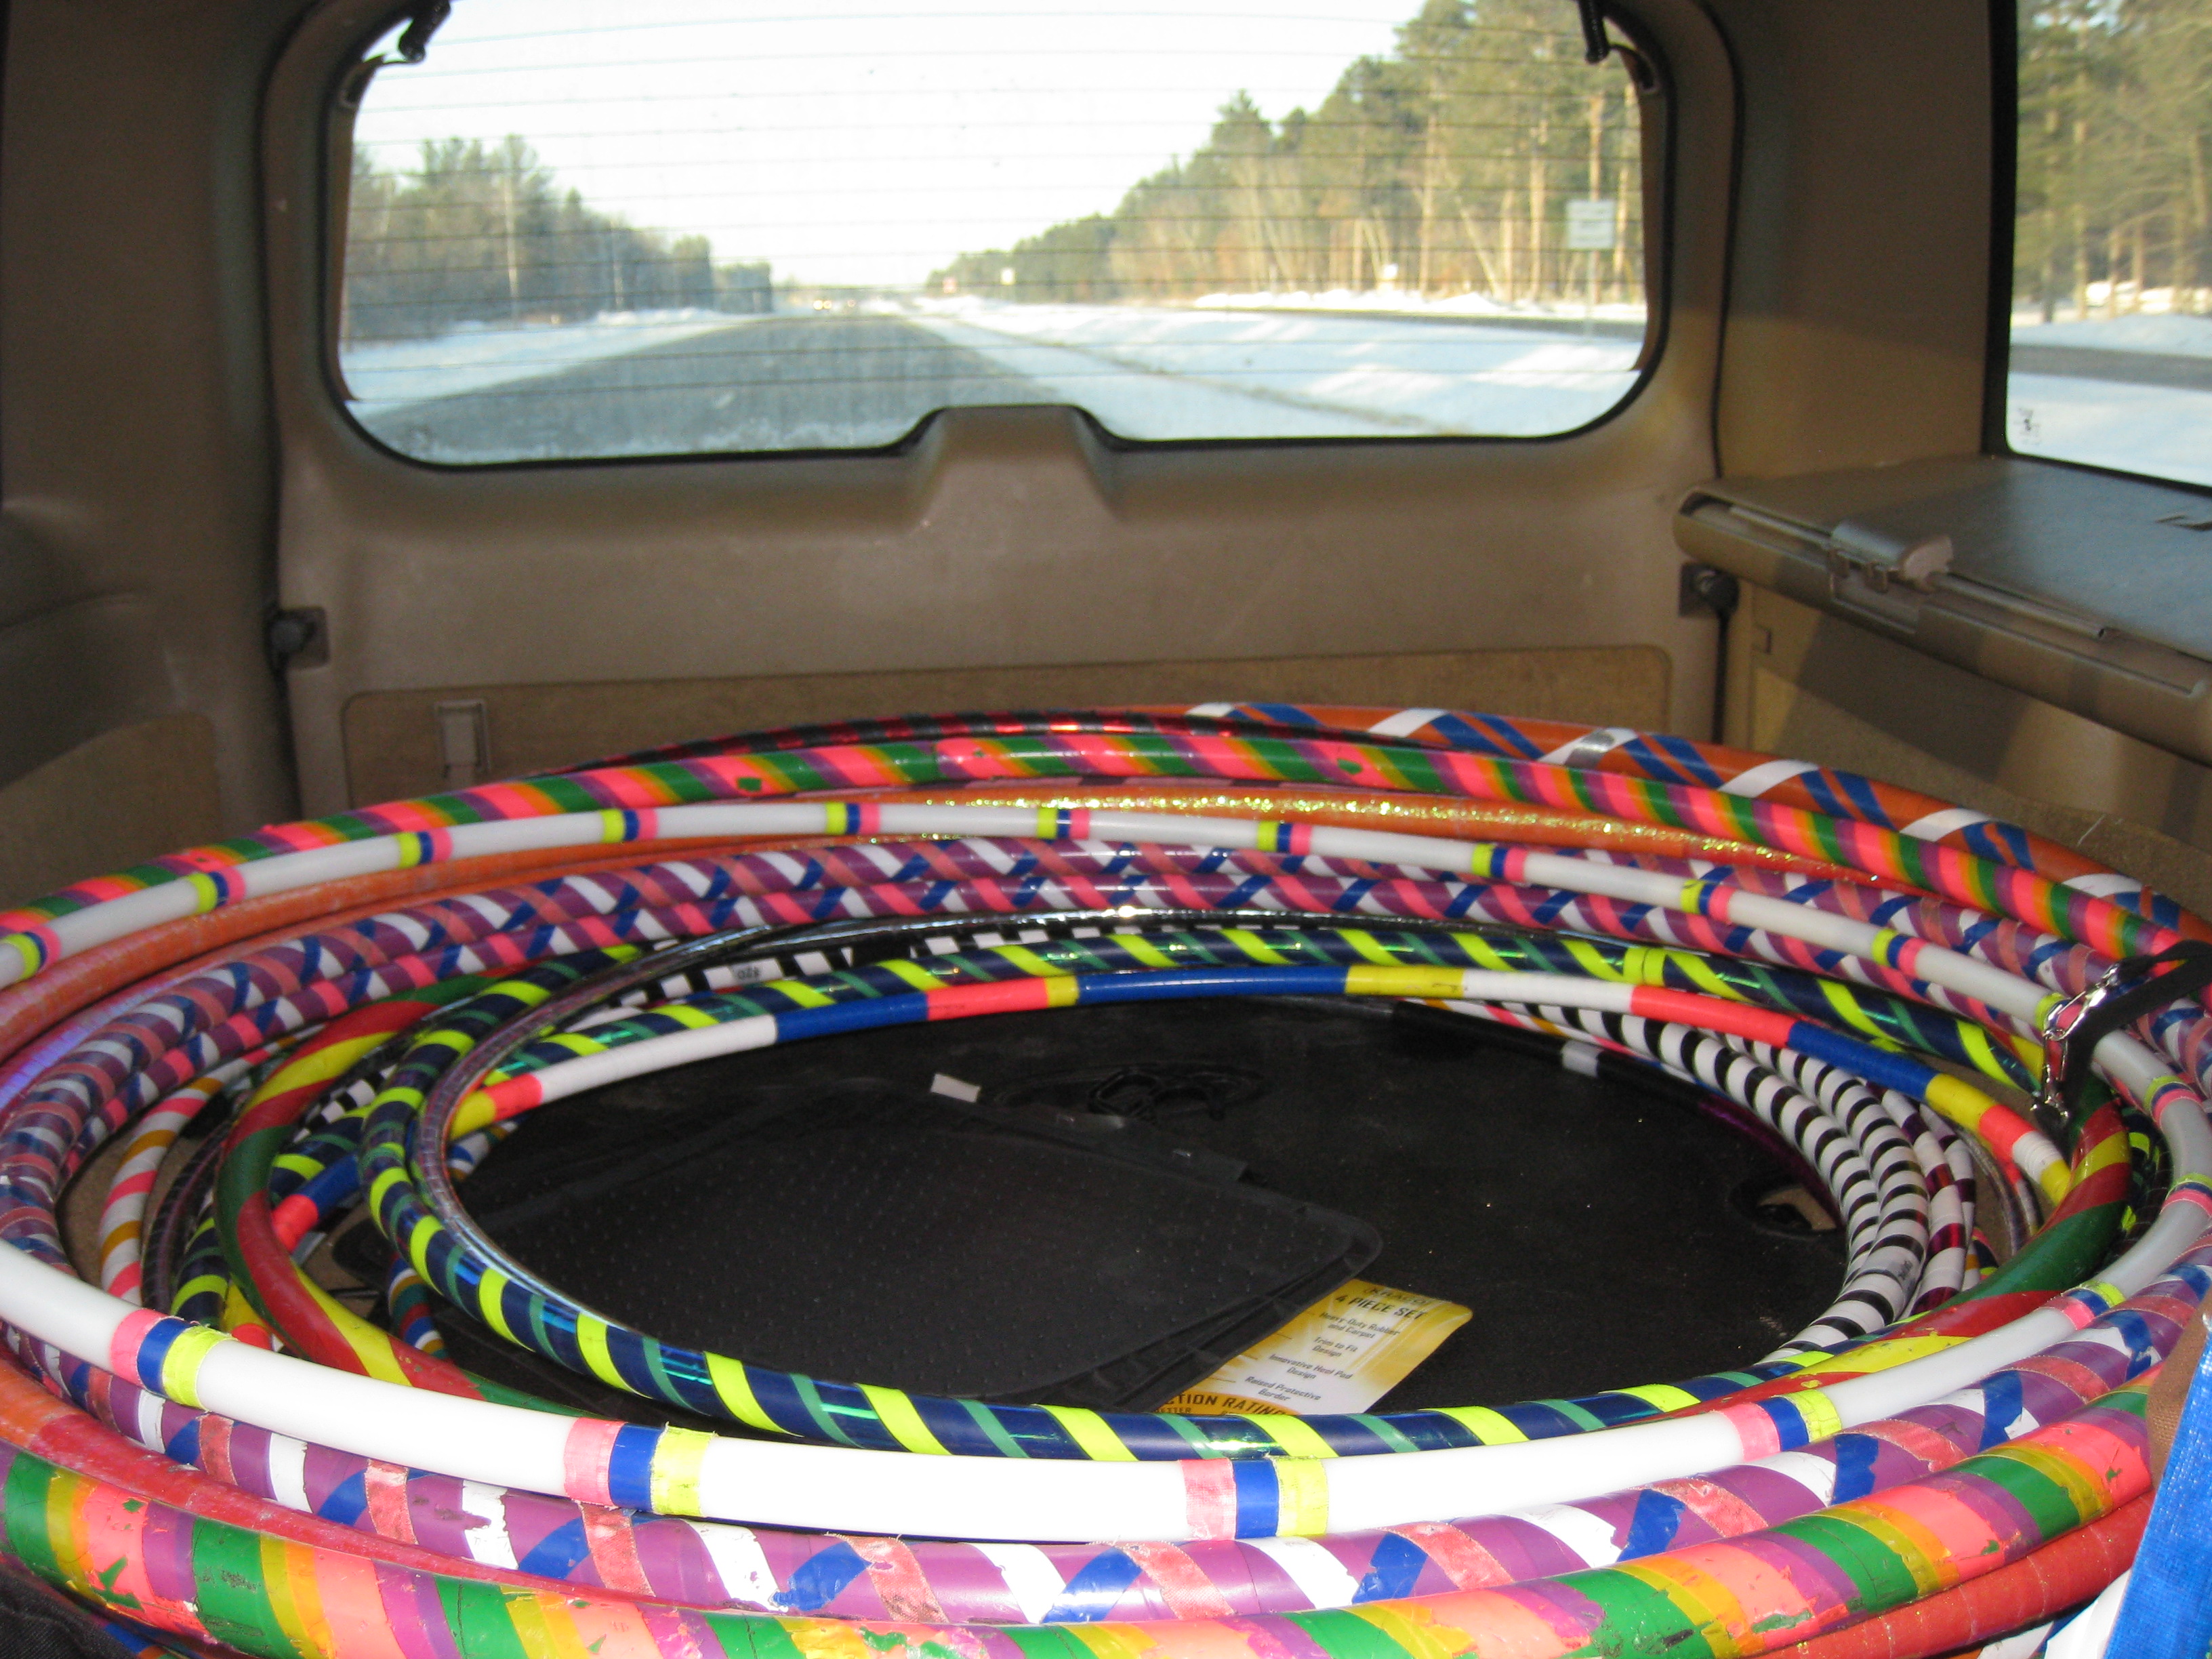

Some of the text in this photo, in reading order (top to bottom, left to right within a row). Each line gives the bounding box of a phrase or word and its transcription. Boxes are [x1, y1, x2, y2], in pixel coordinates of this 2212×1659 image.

[1335, 1295, 1427, 1320] 4 PIECE SET
[1345, 1326, 1376, 1338] Carpet
[1368, 1323, 1401, 1336] Rubber
[1312, 1345, 1342, 1357] Design
[1314, 1336, 1334, 1347] Trim
[1345, 1345, 1358, 1353] Fit
[1269, 1353, 1353, 1380] Innovative Heel Pad
[1287, 1367, 1317, 1380] Design
[1245, 1376, 1322, 1401] Raised Protective
[1258, 1389, 1290, 1401] Border
